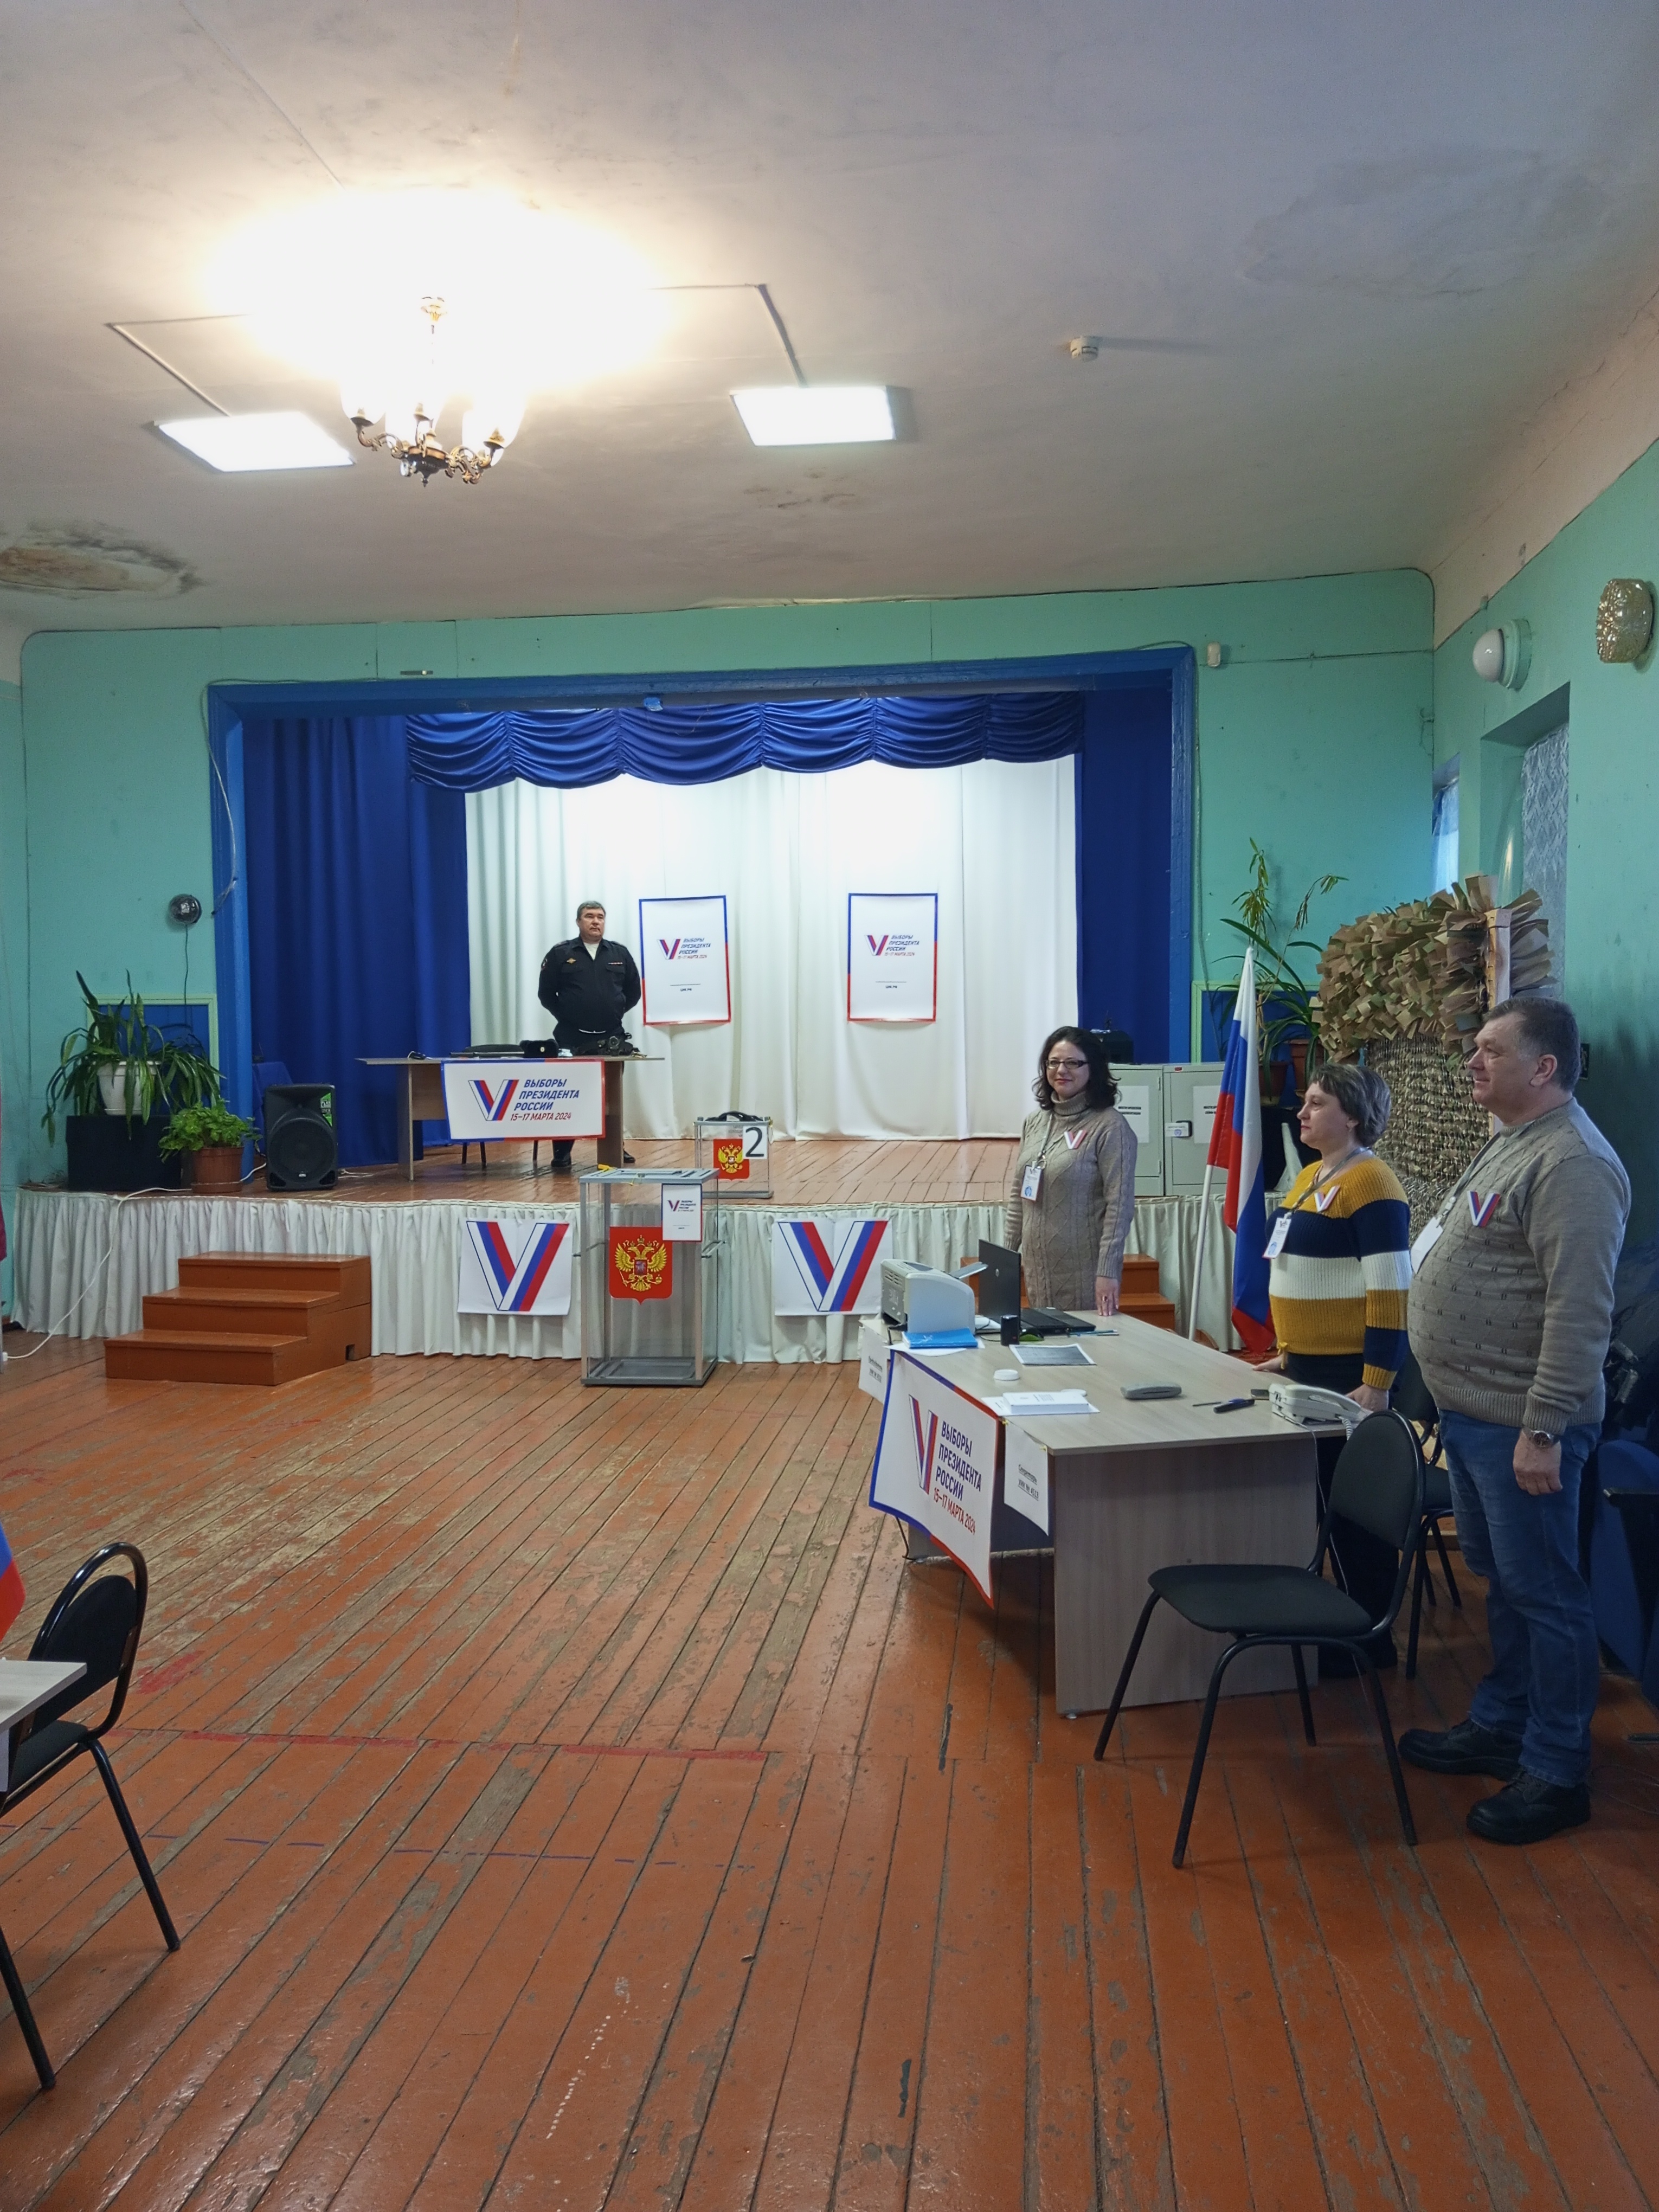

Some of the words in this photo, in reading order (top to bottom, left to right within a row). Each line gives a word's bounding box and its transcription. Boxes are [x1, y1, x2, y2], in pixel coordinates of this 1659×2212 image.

[519, 1090, 580, 1100] ПРЕЗИДЕНТА
[524, 1078, 567, 1088] ВЫБОРЫ
[513, 1102, 554, 1111] РОССИИ
[530, 1113, 554, 1121] МАРТА
[554, 1112, 572, 1120] 2024
[745, 1127, 764, 1157] 2
[941, 1420, 973, 1457] ВЫБОРЫ
[938, 1443, 982, 1492] ПРЕЗИДЕНТА
[935, 1465, 964, 1501] РОССИИ
[947, 1500, 964, 1526] МАРТА
[964, 1513, 976, 1535] 2024
